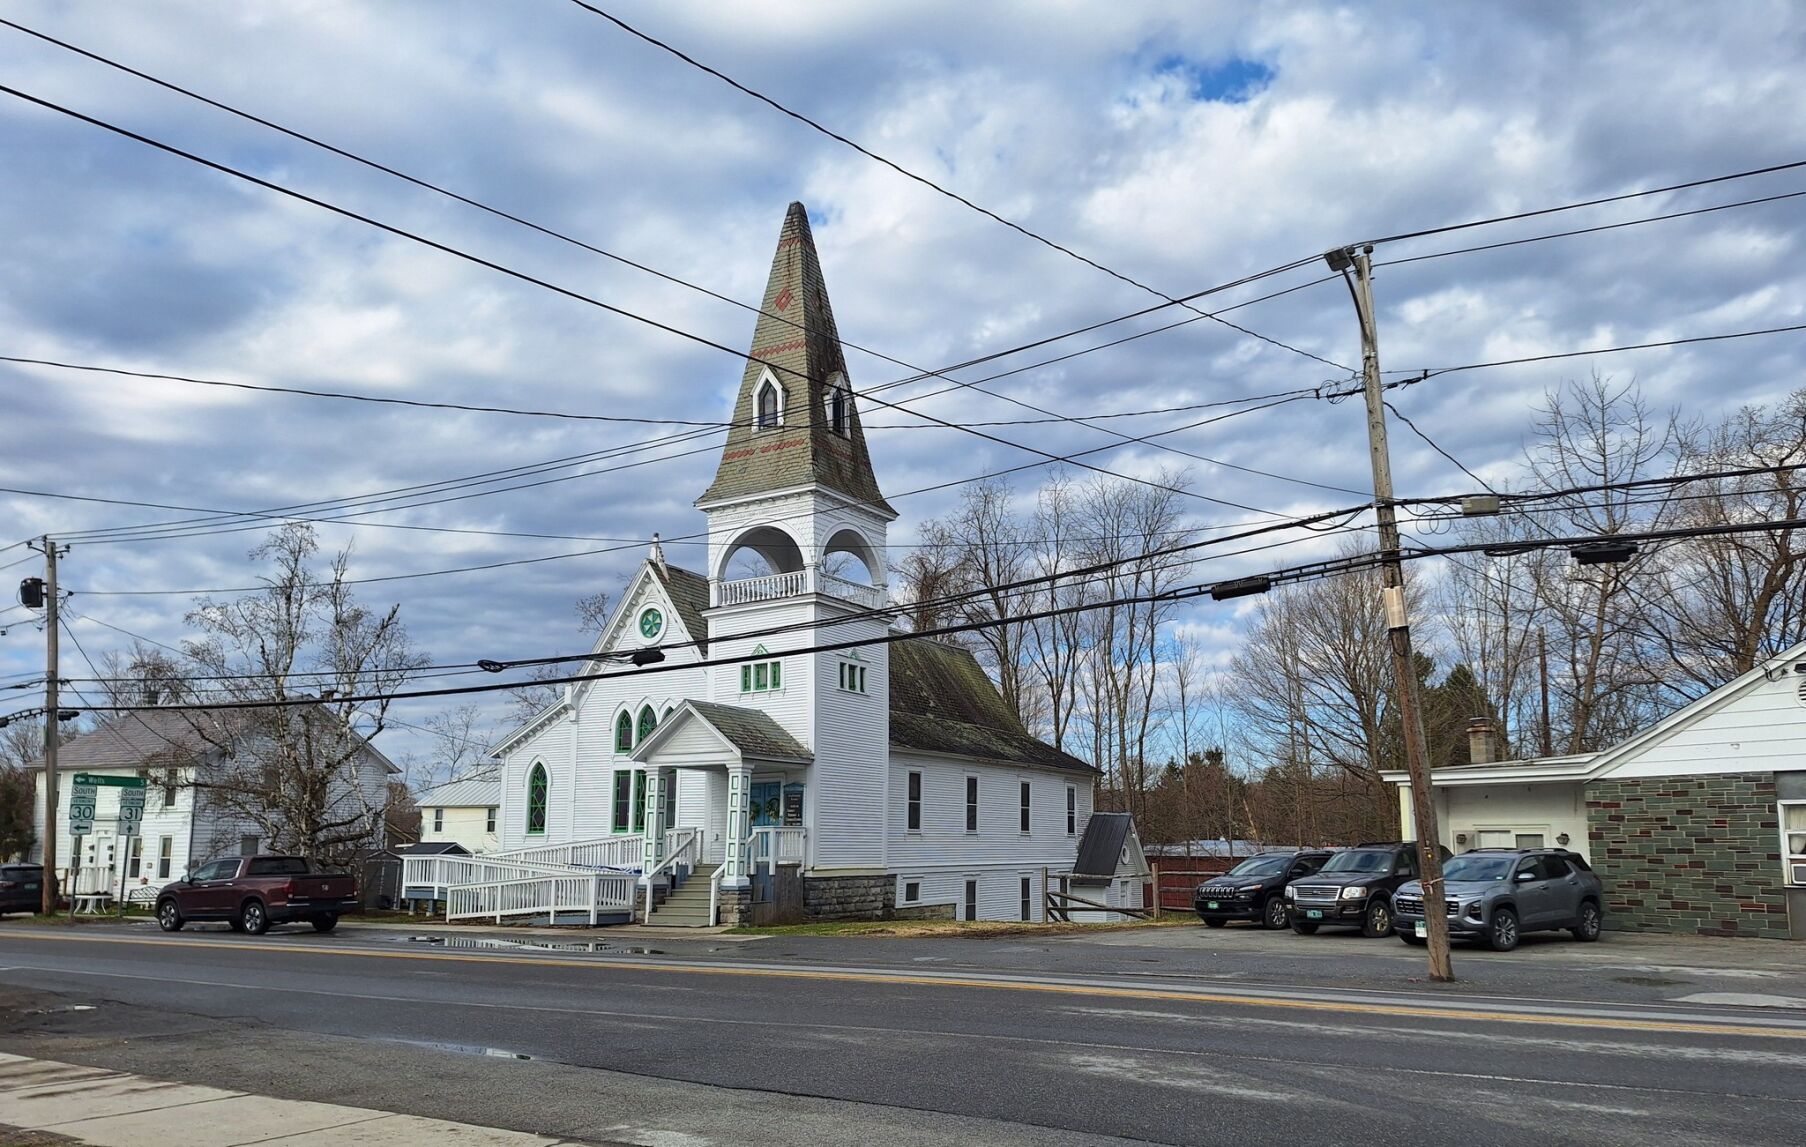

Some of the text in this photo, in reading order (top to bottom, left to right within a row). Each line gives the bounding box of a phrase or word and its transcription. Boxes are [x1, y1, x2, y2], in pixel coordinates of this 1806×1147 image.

[73, 786, 96, 795] SOUTH
[123, 788, 144, 797] SOUTH
[72, 806, 92, 819] 30
[124, 807, 139, 820] 31
